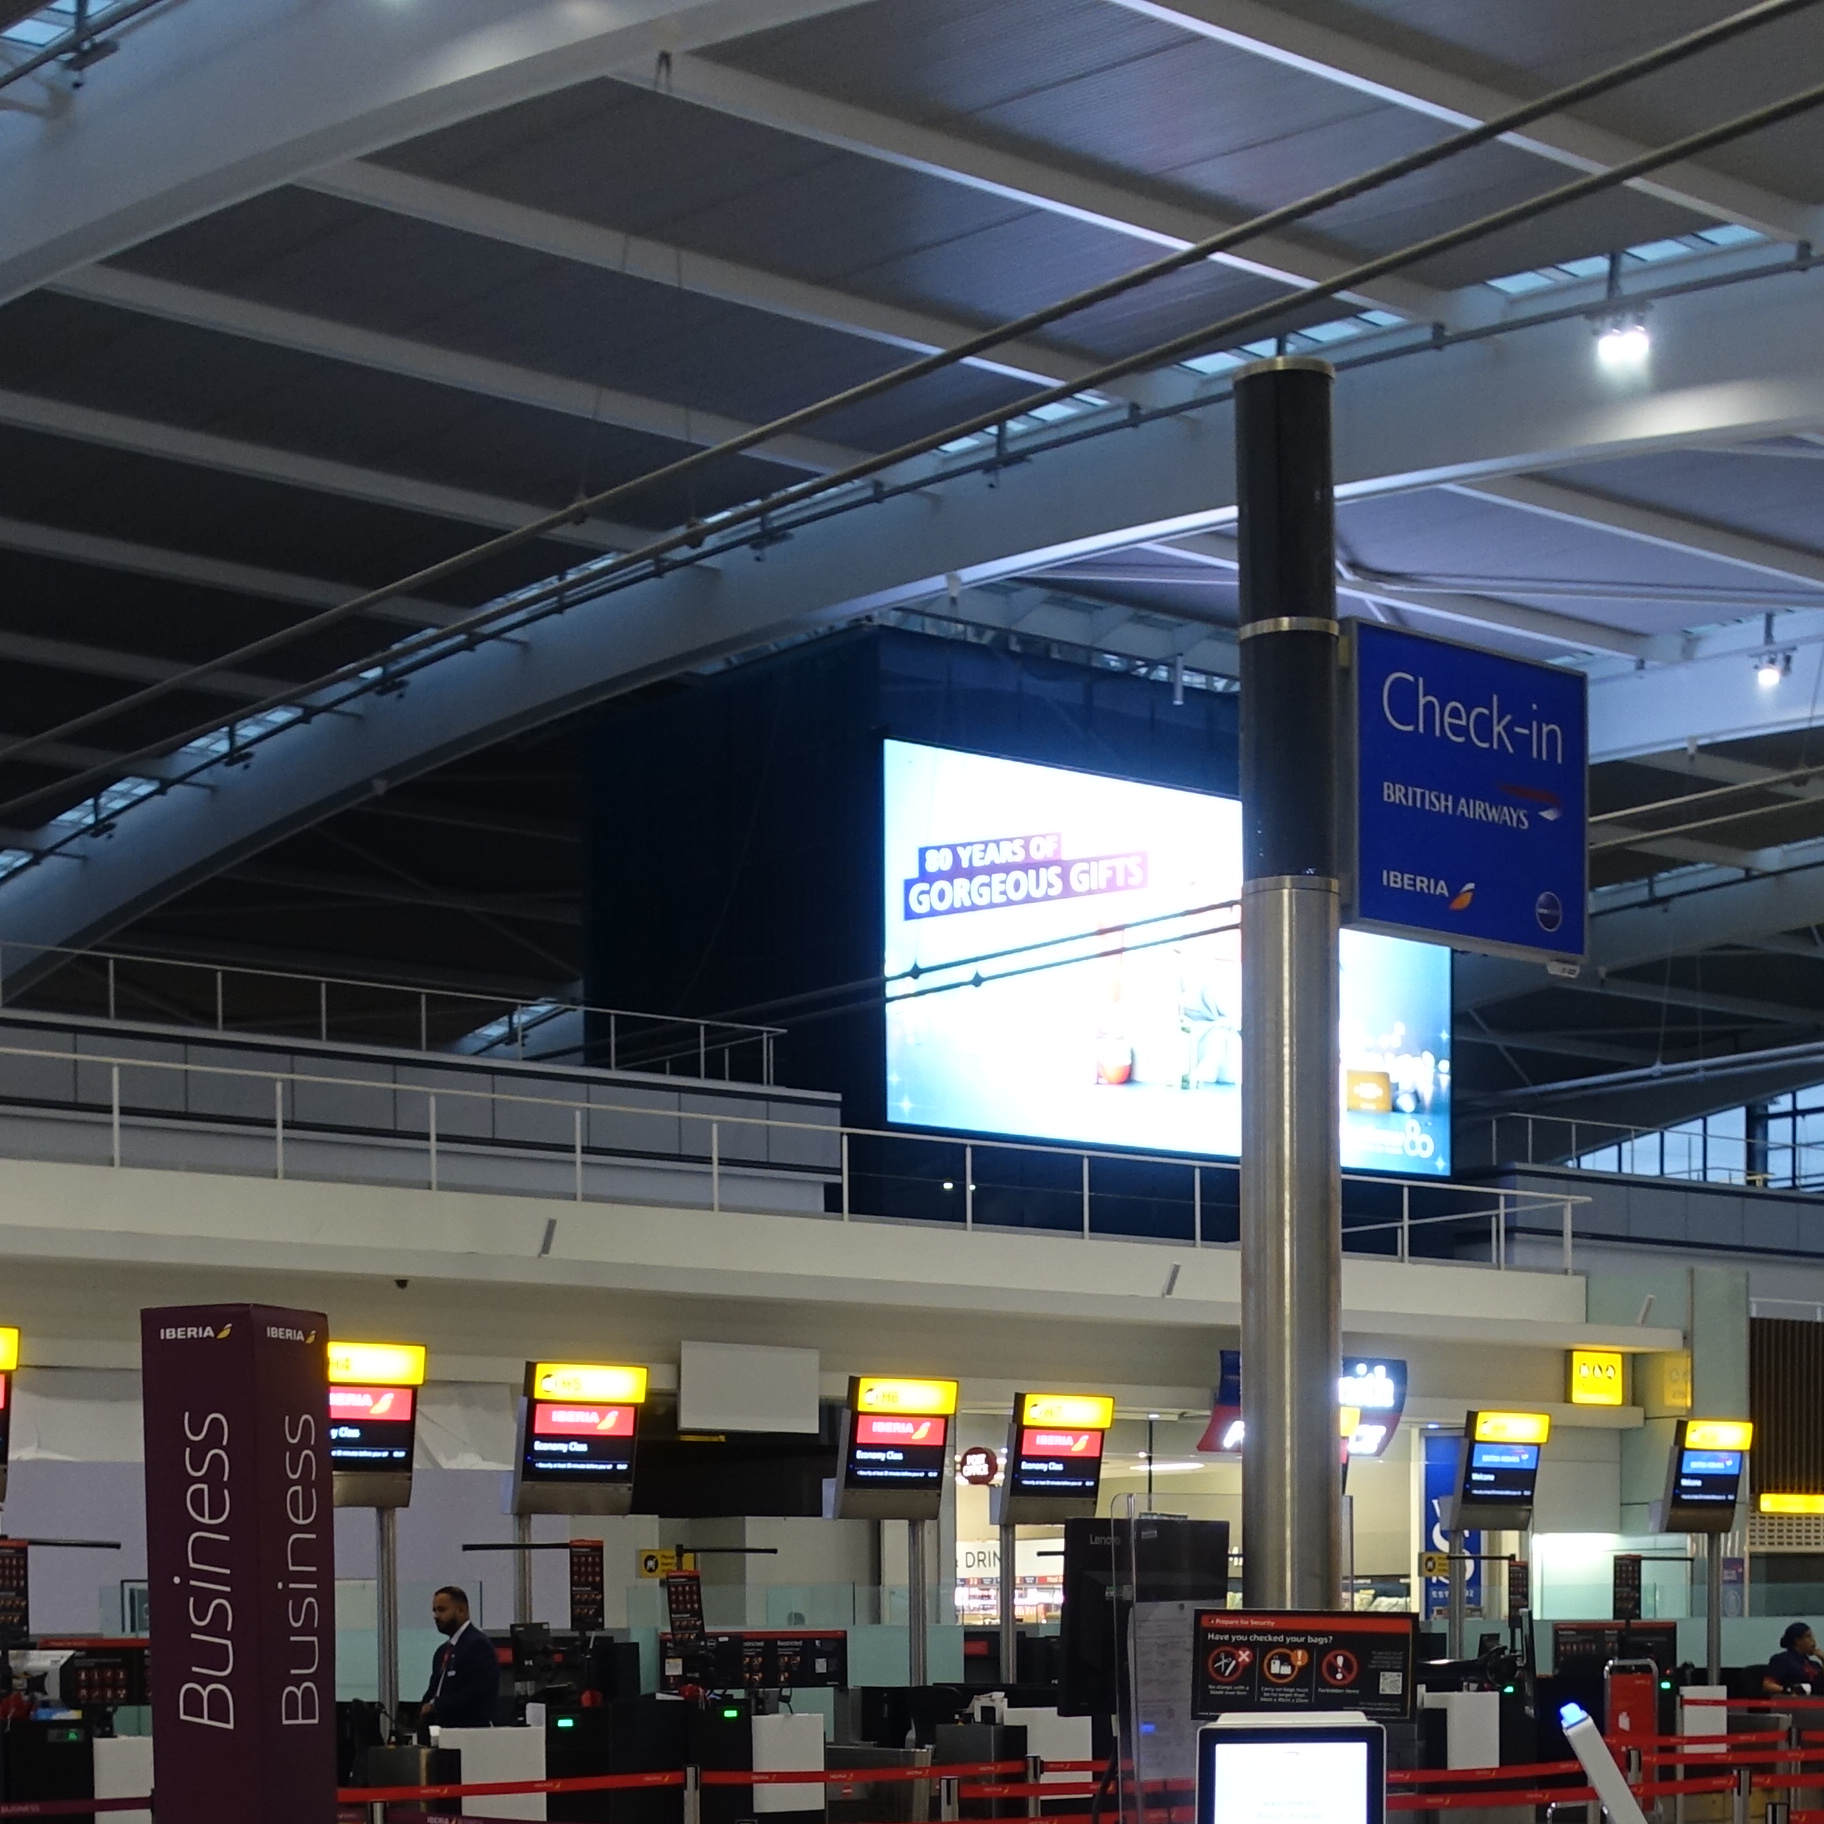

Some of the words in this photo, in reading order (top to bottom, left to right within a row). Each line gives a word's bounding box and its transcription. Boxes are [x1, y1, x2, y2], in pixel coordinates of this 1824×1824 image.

[1382, 671, 1563, 765] Check-in
[1382, 781, 1453, 815] BRITISH
[1456, 797, 1530, 830] AIRWAYS
[956, 838, 1026, 868] YEARS
[1028, 834, 1059, 860] OF
[908, 865, 1063, 914] GORGEOUS
[1069, 855, 1144, 893] GIFTS
[1382, 869, 1450, 897] IBERIA
[159, 1326, 215, 1340] IBERIA
[266, 1326, 305, 1342] IBERIA
[872, 1421, 914, 1434] IBERIA
[1036, 1434, 1074, 1446] IBERIA
[966, 1454, 987, 1466] POST
[962, 1464, 989, 1476] OFFICE
[1089, 1534, 1121, 1545] Lenovo
[965, 1550, 1001, 1568] DRIN
[173, 1411, 234, 1730] Business
[277, 1413, 320, 1725] Business
[1207, 1632, 1229, 1641] Have
[1231, 1634, 1248, 1643] you
[1249, 1633, 1283, 1642] checked
[1285, 1635, 1305, 1644] your
[1307, 1635, 1333, 1645] bags?
